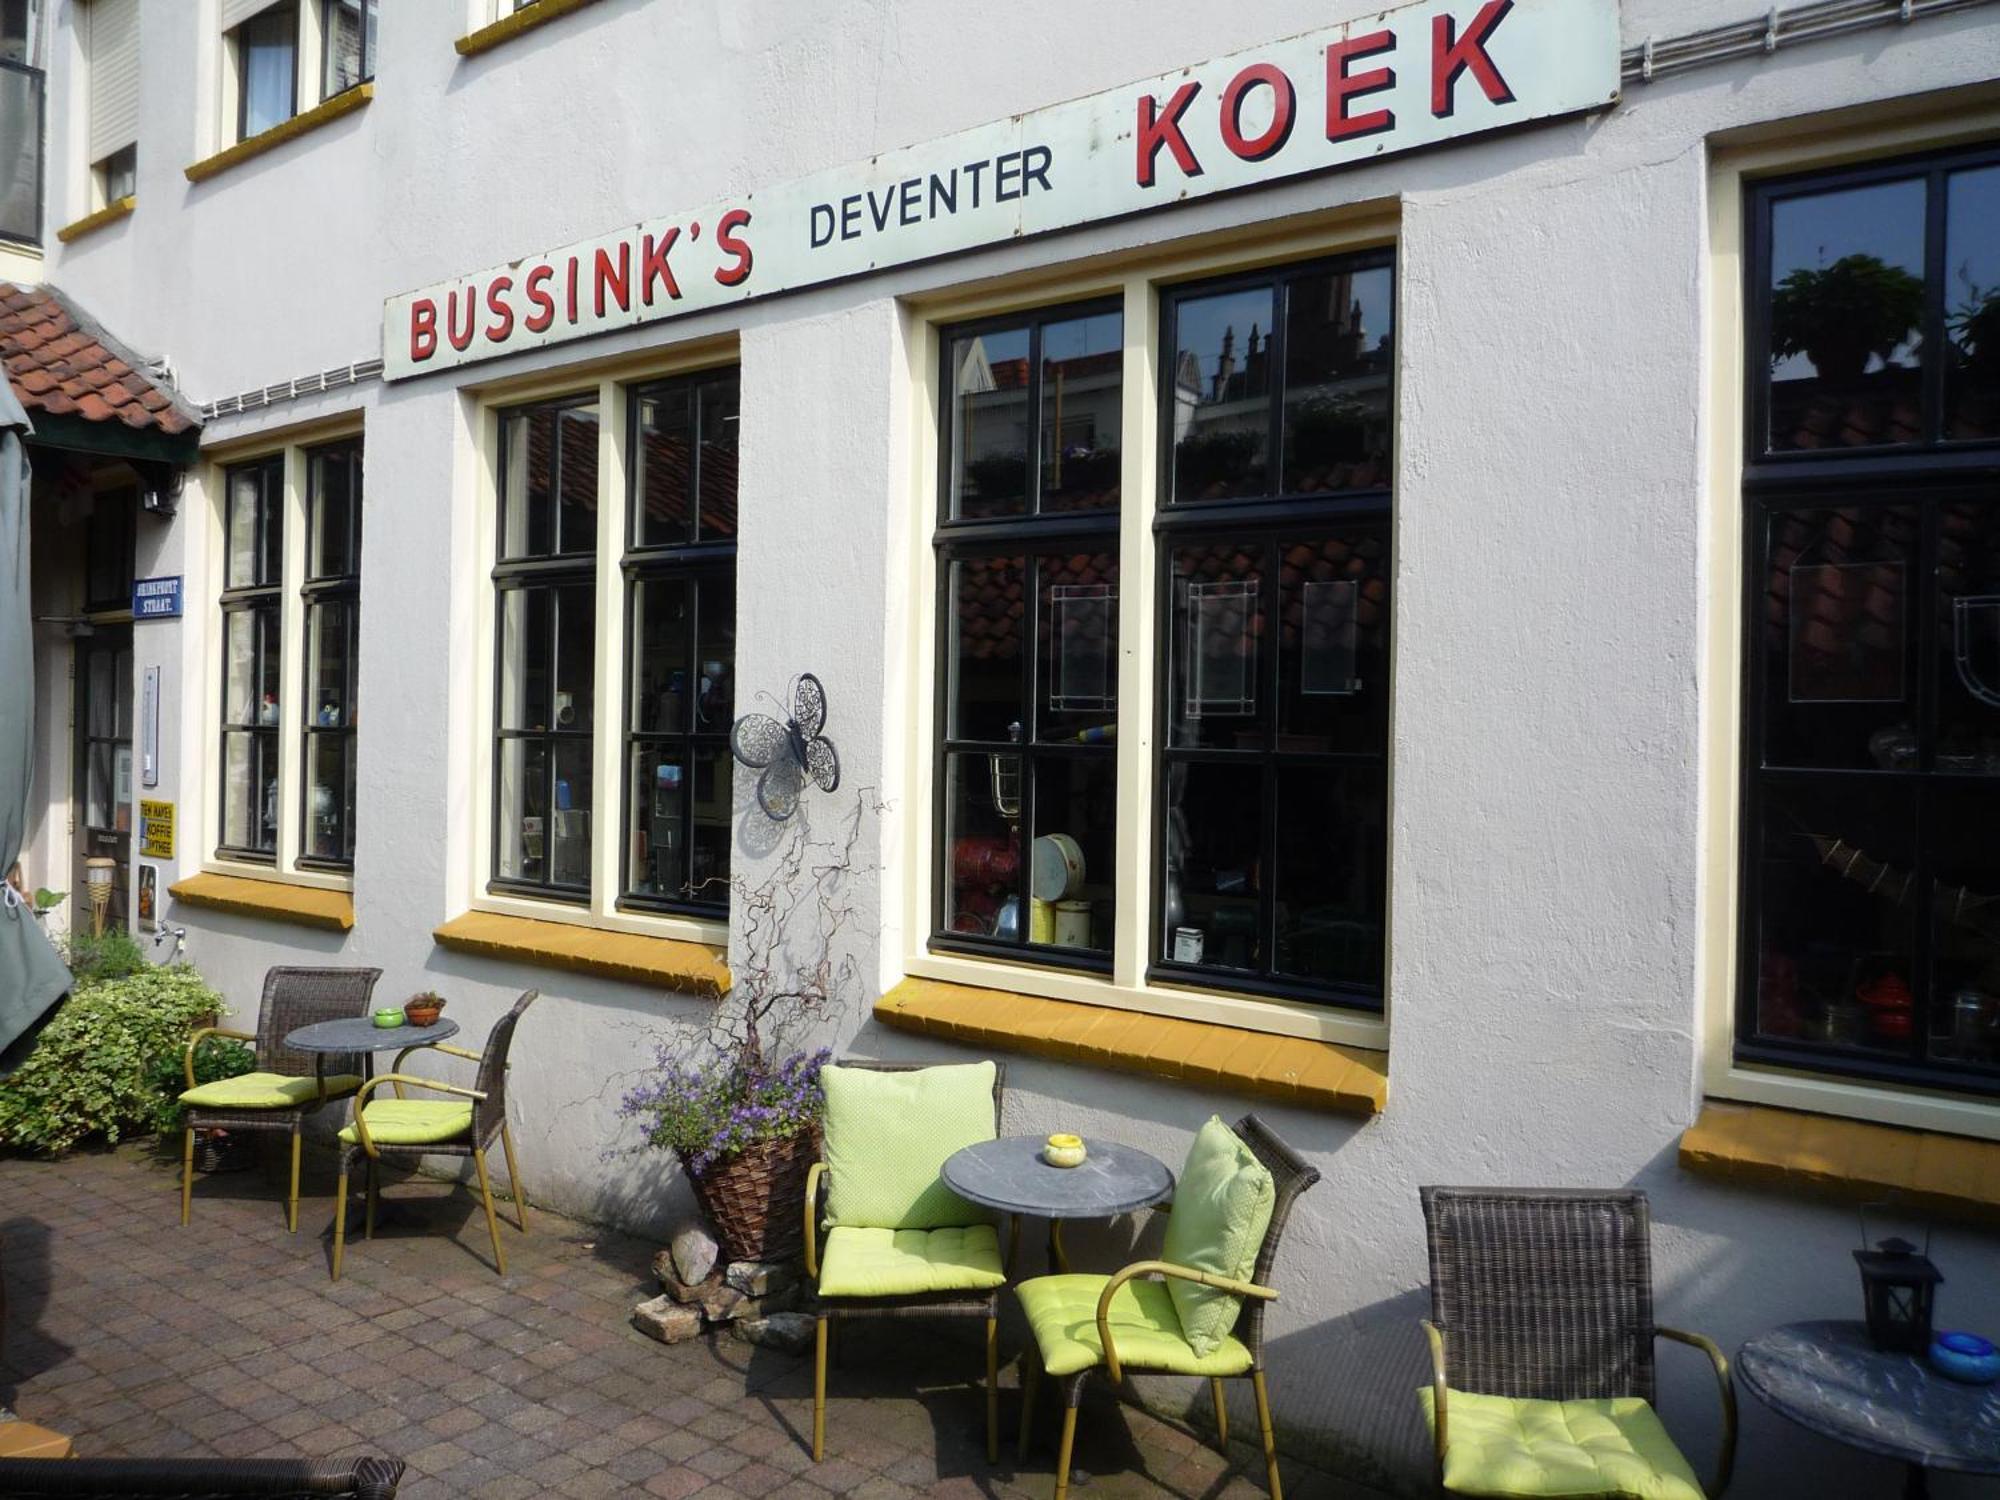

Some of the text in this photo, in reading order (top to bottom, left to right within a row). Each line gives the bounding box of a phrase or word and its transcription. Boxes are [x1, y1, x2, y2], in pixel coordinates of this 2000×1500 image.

[410, 0, 1518, 363] BUSSINK'S DEVENTER KOEK
[147, 822, 172, 839] KOFFIE
